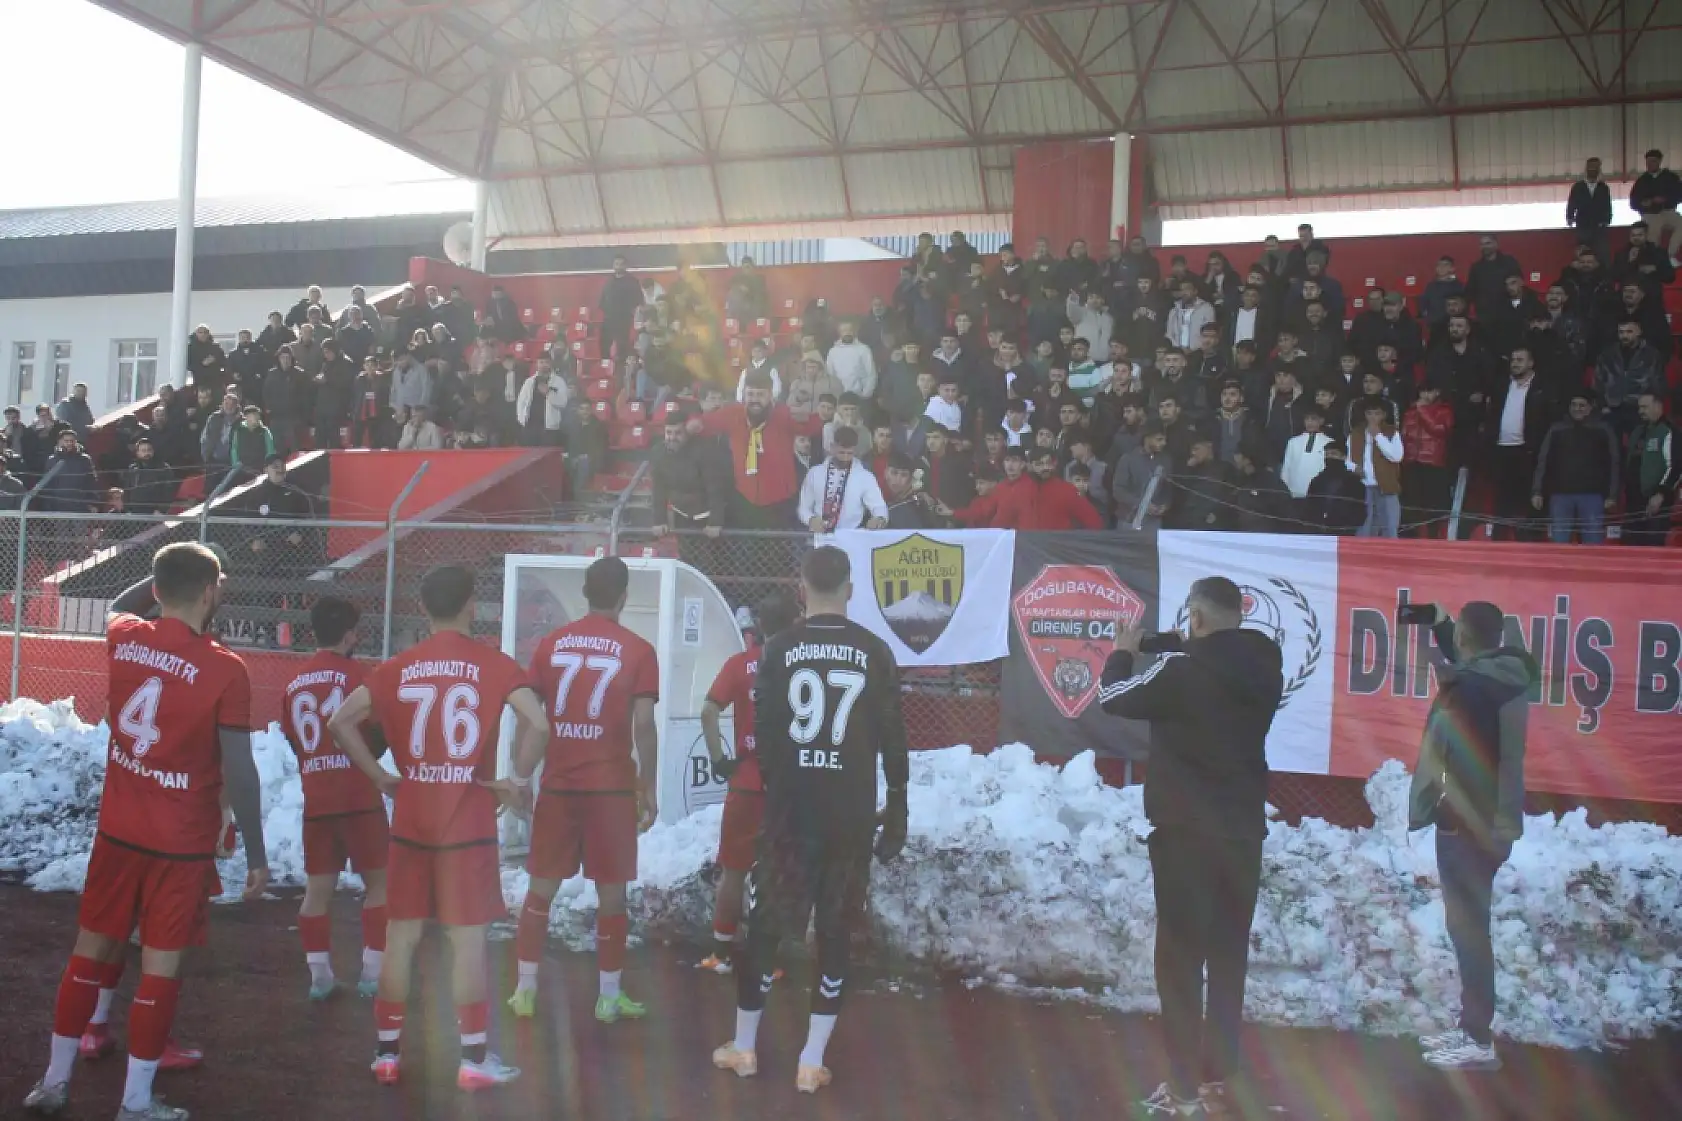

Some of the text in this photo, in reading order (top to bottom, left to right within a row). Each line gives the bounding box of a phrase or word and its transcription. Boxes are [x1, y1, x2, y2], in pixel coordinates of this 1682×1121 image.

[898, 547, 940, 565] AĞRI
[1023, 581, 1128, 608] DOĞUBAYAZIT
[1032, 617, 1116, 640] DİRENİŞ 04
[553, 632, 623, 658] DOĞUBAYAZIT FK
[785, 641, 854, 668] DOĞUBAYAZIT
[854, 650, 868, 670] FK
[113, 640, 199, 685] DOĞUBAYAZIT FK
[400, 660, 480, 684] DOĞUBAYAZIT FK
[1635, 620, 1682, 713] B
[550, 652, 622, 720] 77
[118, 676, 162, 757] 4
[397, 683, 480, 759] 76
[787, 668, 866, 746] 97
[555, 722, 604, 740] YAKUP
[798, 748, 844, 771] E.D.E.
